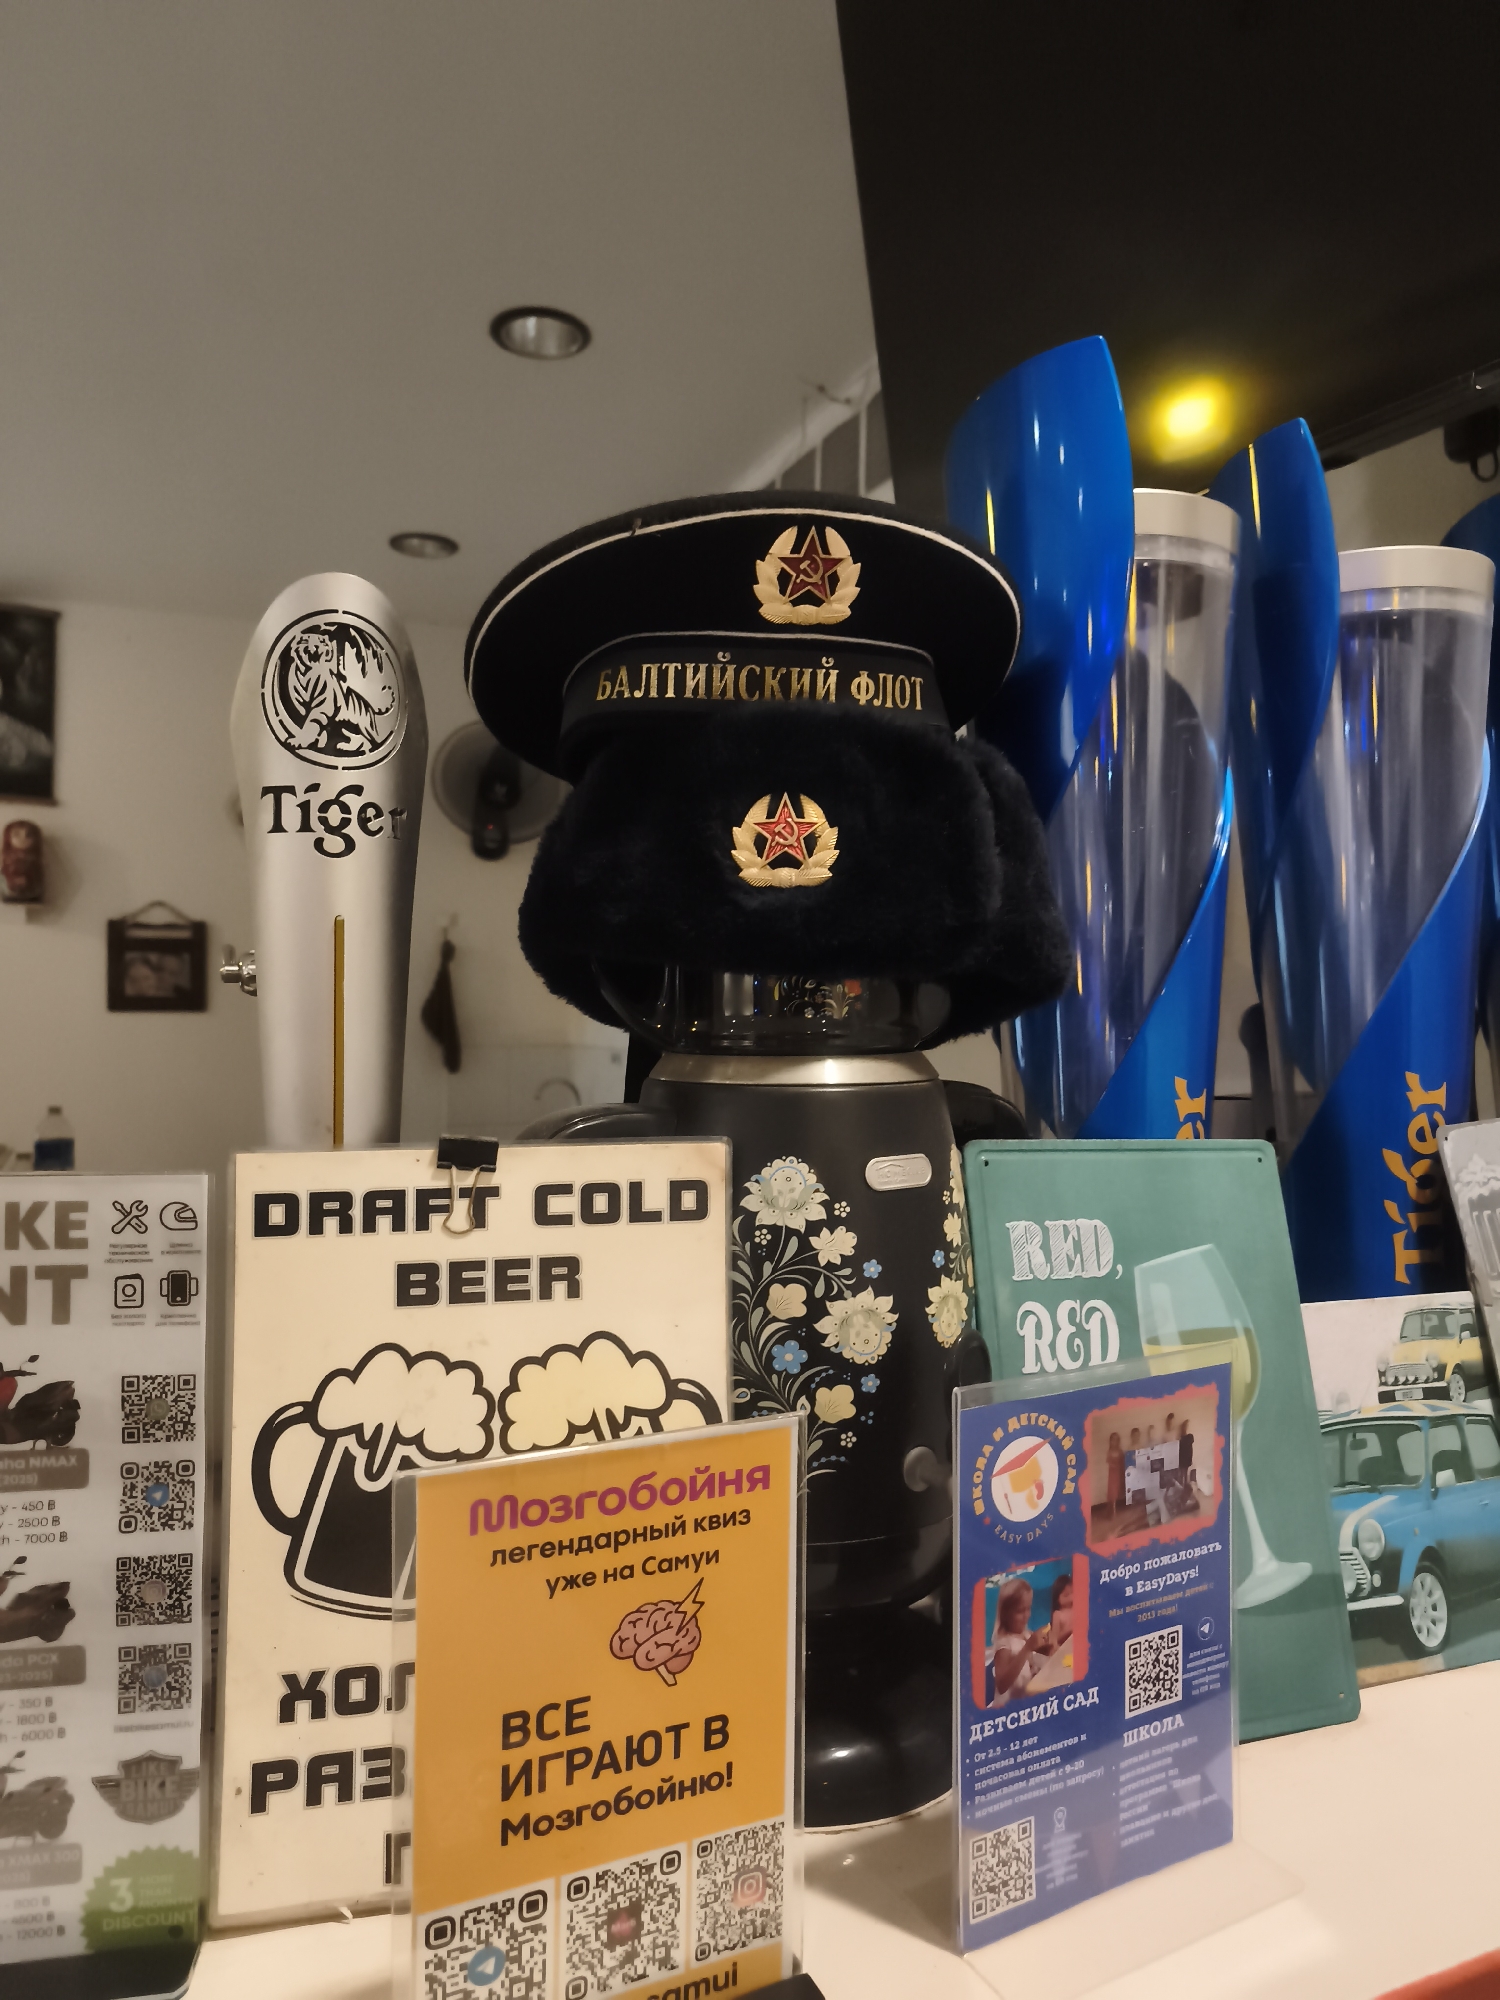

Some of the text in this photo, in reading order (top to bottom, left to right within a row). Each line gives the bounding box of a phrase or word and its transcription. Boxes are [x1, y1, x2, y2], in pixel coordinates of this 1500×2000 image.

[596, 652, 924, 710] БАЛТИЙСКИЙ ФЛОТ
[261, 782, 407, 858] Tiger
[252, 1178, 710, 1239] DRAFT COLD
[1005, 1218, 1123, 1281] RED,
[394, 1254, 582, 1308] BEER
[1016, 1298, 1120, 1375] RED
[29, 1454, 78, 1468] NMAX
[17, 1517, 48, 1528] 2500
[22, 1500, 44, 1511] 450
[469, 1464, 771, 1536] Мозгобойня
[25, 1533, 55, 1544] 7000
[490, 1509, 751, 1567] легендарный квиз
[994, 1513, 1054, 1544] EASY DAYS
[545, 1549, 720, 1599] уже на Самуи
[1099, 1542, 1222, 1585] Добро пожаловать
[1125, 1565, 1199, 1597] в EasyDays!
[501, 1696, 591, 1751] ВСЕ
[969, 1686, 1100, 1745] ДЕТСКИЙ САД
[1122, 1714, 1185, 1748] ШКОЛА
[500, 1714, 731, 1802] ИГРАЮТ В
[1009, 1740, 1020, 1751] 12
[500, 1761, 733, 1846] Мозгобойню!
[102, 1911, 196, 1931] DISCOUNT
[109, 1877, 134, 1913] 3
